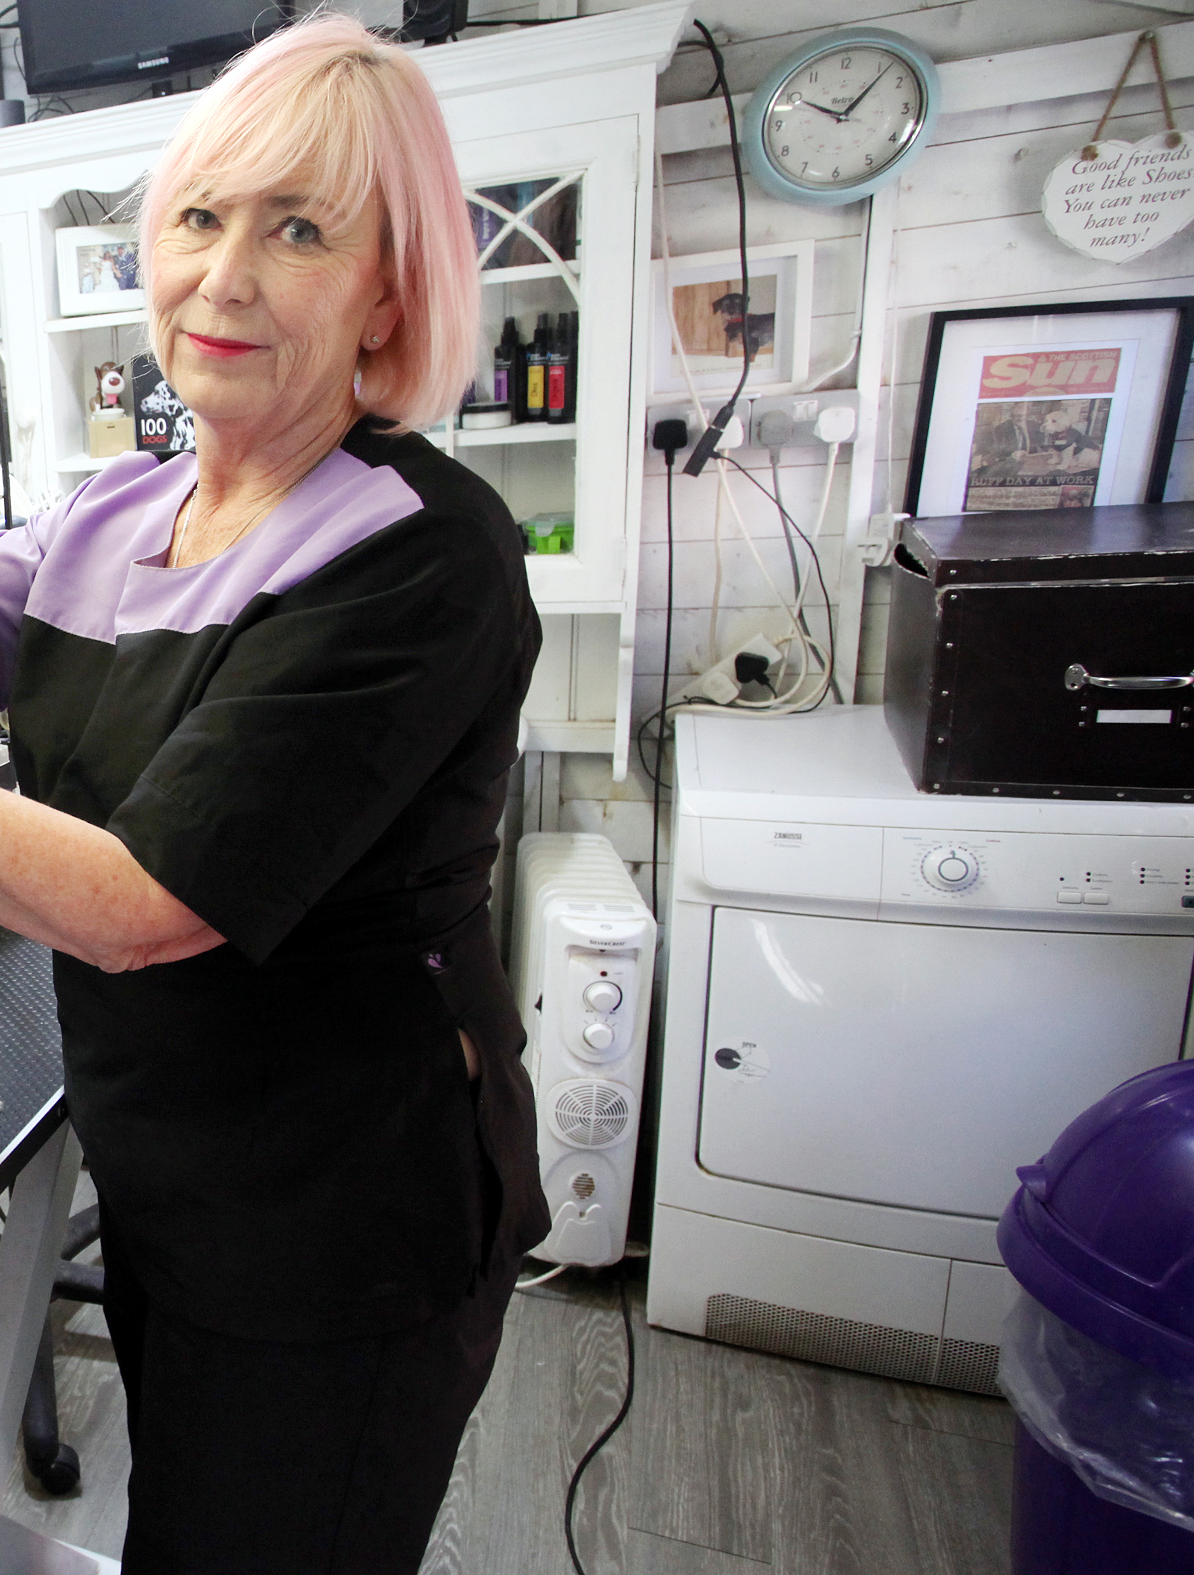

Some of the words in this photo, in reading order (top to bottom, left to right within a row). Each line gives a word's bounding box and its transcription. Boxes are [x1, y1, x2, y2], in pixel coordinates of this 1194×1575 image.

[138, 57, 169, 69] SAMSUNG
[840, 57, 852, 70] 12
[809, 71, 819, 83] 11
[894, 76, 904, 90] 2
[786, 91, 803, 104] 10
[831, 96, 855, 105] Retro
[900, 102, 910, 115] 3
[775, 120, 783, 132] 9
[888, 131, 897, 144] 4
[781, 145, 790, 157] 8
[865, 154, 874, 166] 5
[1072, 153, 1123, 175] Good
[1122, 144, 1192, 173] friends
[801, 161, 809, 174] 7
[831, 166, 840, 179] 6
[1065, 181, 1095, 196] are
[1100, 172, 1137, 191] like
[1064, 198, 1095, 214] You
[1100, 195, 1133, 209] can
[1139, 187, 1191, 204] never
[1083, 213, 1128, 230] have
[1132, 211, 1160, 225] too
[1089, 227, 1150, 248] many!
[1049, 353, 1066, 362] THE
[1069, 350, 1117, 361] SCOTTISH
[981, 355, 1117, 389] Sun
[141, 418, 166, 436] 100
[143, 435, 167, 444] DOGS
[970, 476, 1003, 487] RUFF
[1006, 476, 1032, 486] DAY
[1035, 476, 1053, 486] AT
[1055, 475, 1095, 485] WORK
[773, 832, 802, 840] ZANUSSI
